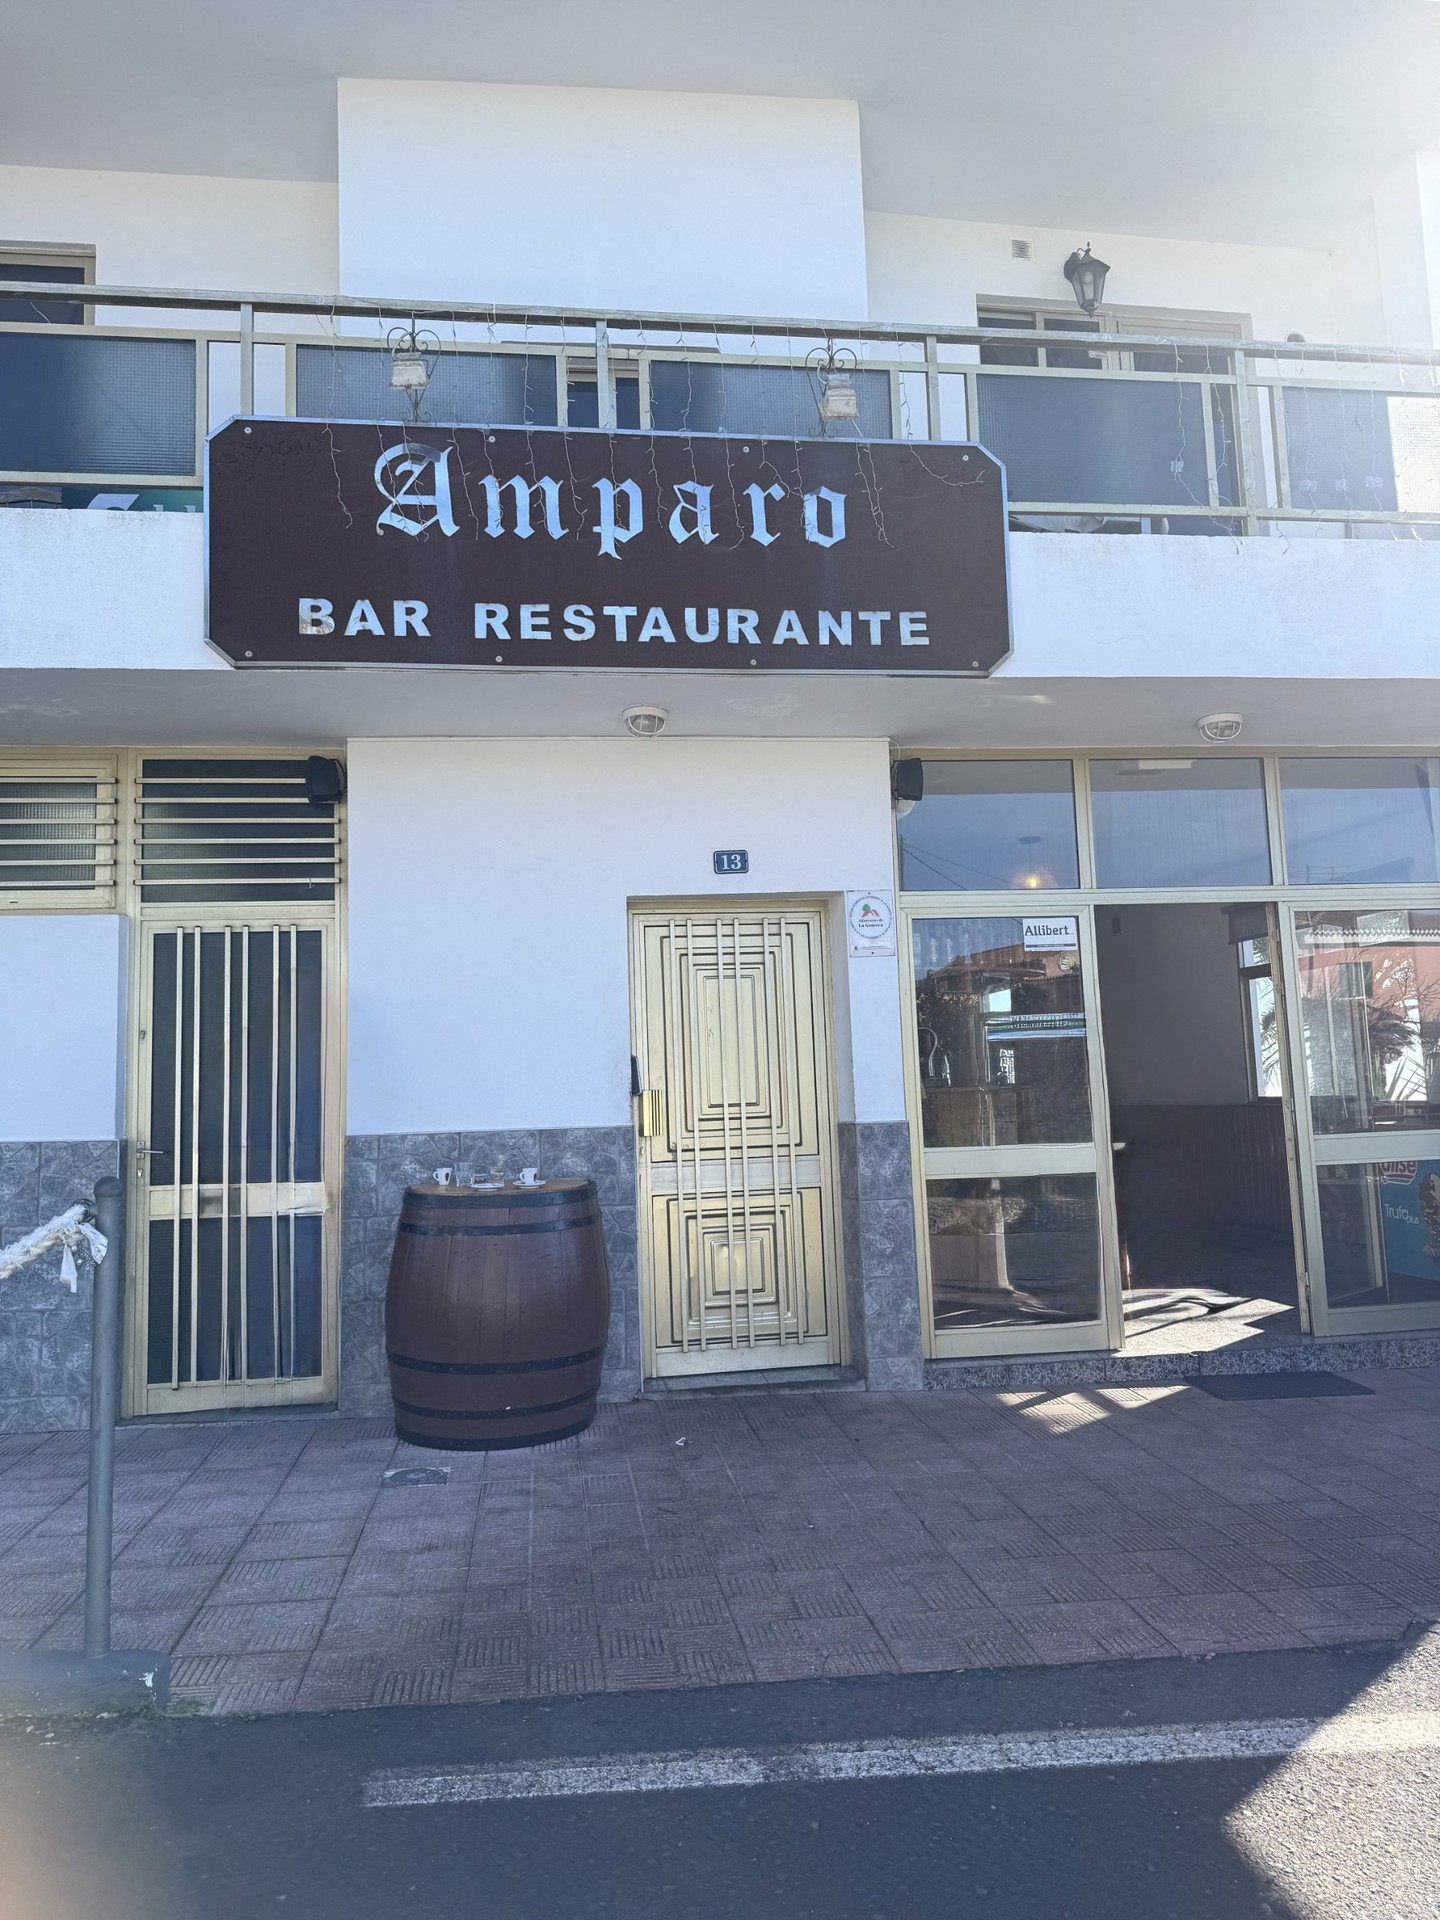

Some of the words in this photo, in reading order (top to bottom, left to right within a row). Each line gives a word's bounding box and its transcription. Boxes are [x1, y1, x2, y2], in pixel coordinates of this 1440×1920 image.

[374, 443, 847, 559] Amparo
[298, 597, 431, 637] BAR
[474, 601, 930, 647] RESTAURANTE
[721, 854, 742, 870] 13
[1025, 925, 1069, 936] Allibert
